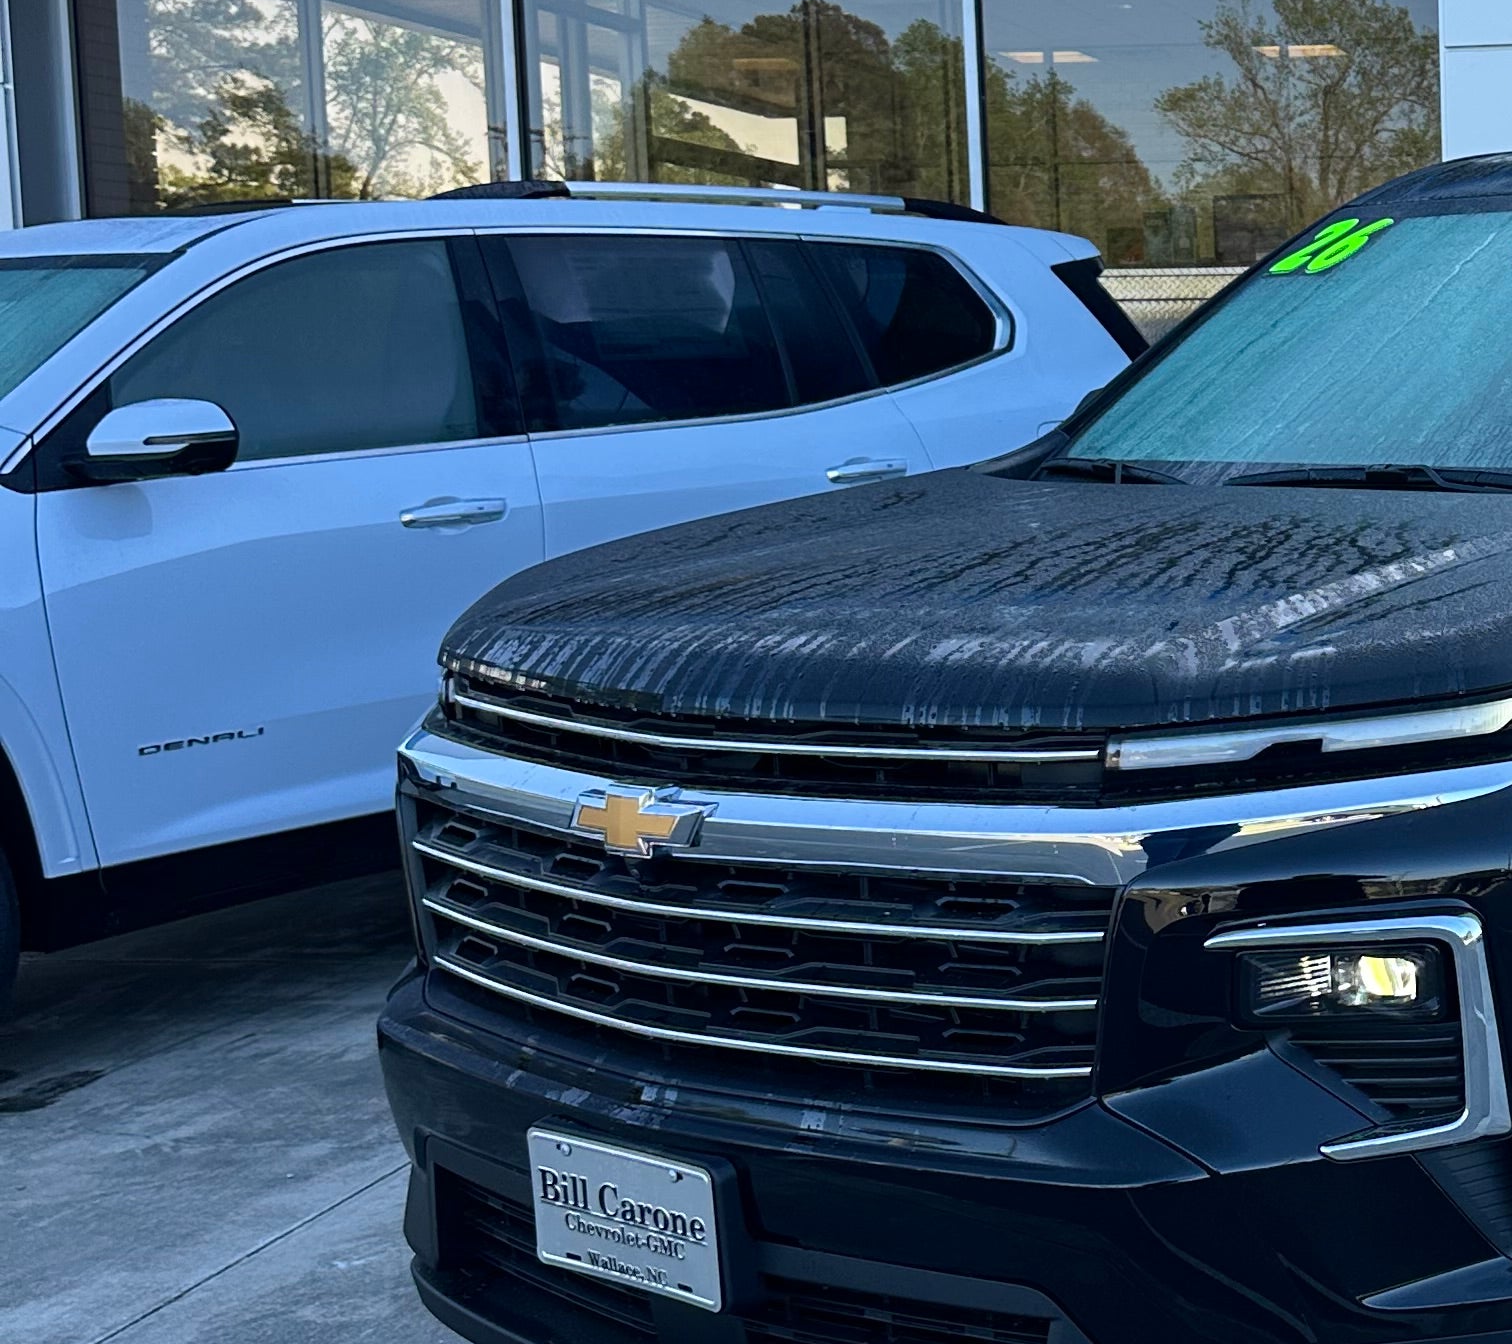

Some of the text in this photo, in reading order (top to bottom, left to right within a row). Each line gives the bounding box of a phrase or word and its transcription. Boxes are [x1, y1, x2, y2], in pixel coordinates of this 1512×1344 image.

[1268, 218, 1395, 274] 26
[138, 727, 264, 756] DENALI
[538, 1166, 707, 1242] Bill Carone
[564, 1211, 686, 1261] Chevrolet-GMC
[587, 1248, 669, 1286] Wallace, NC
